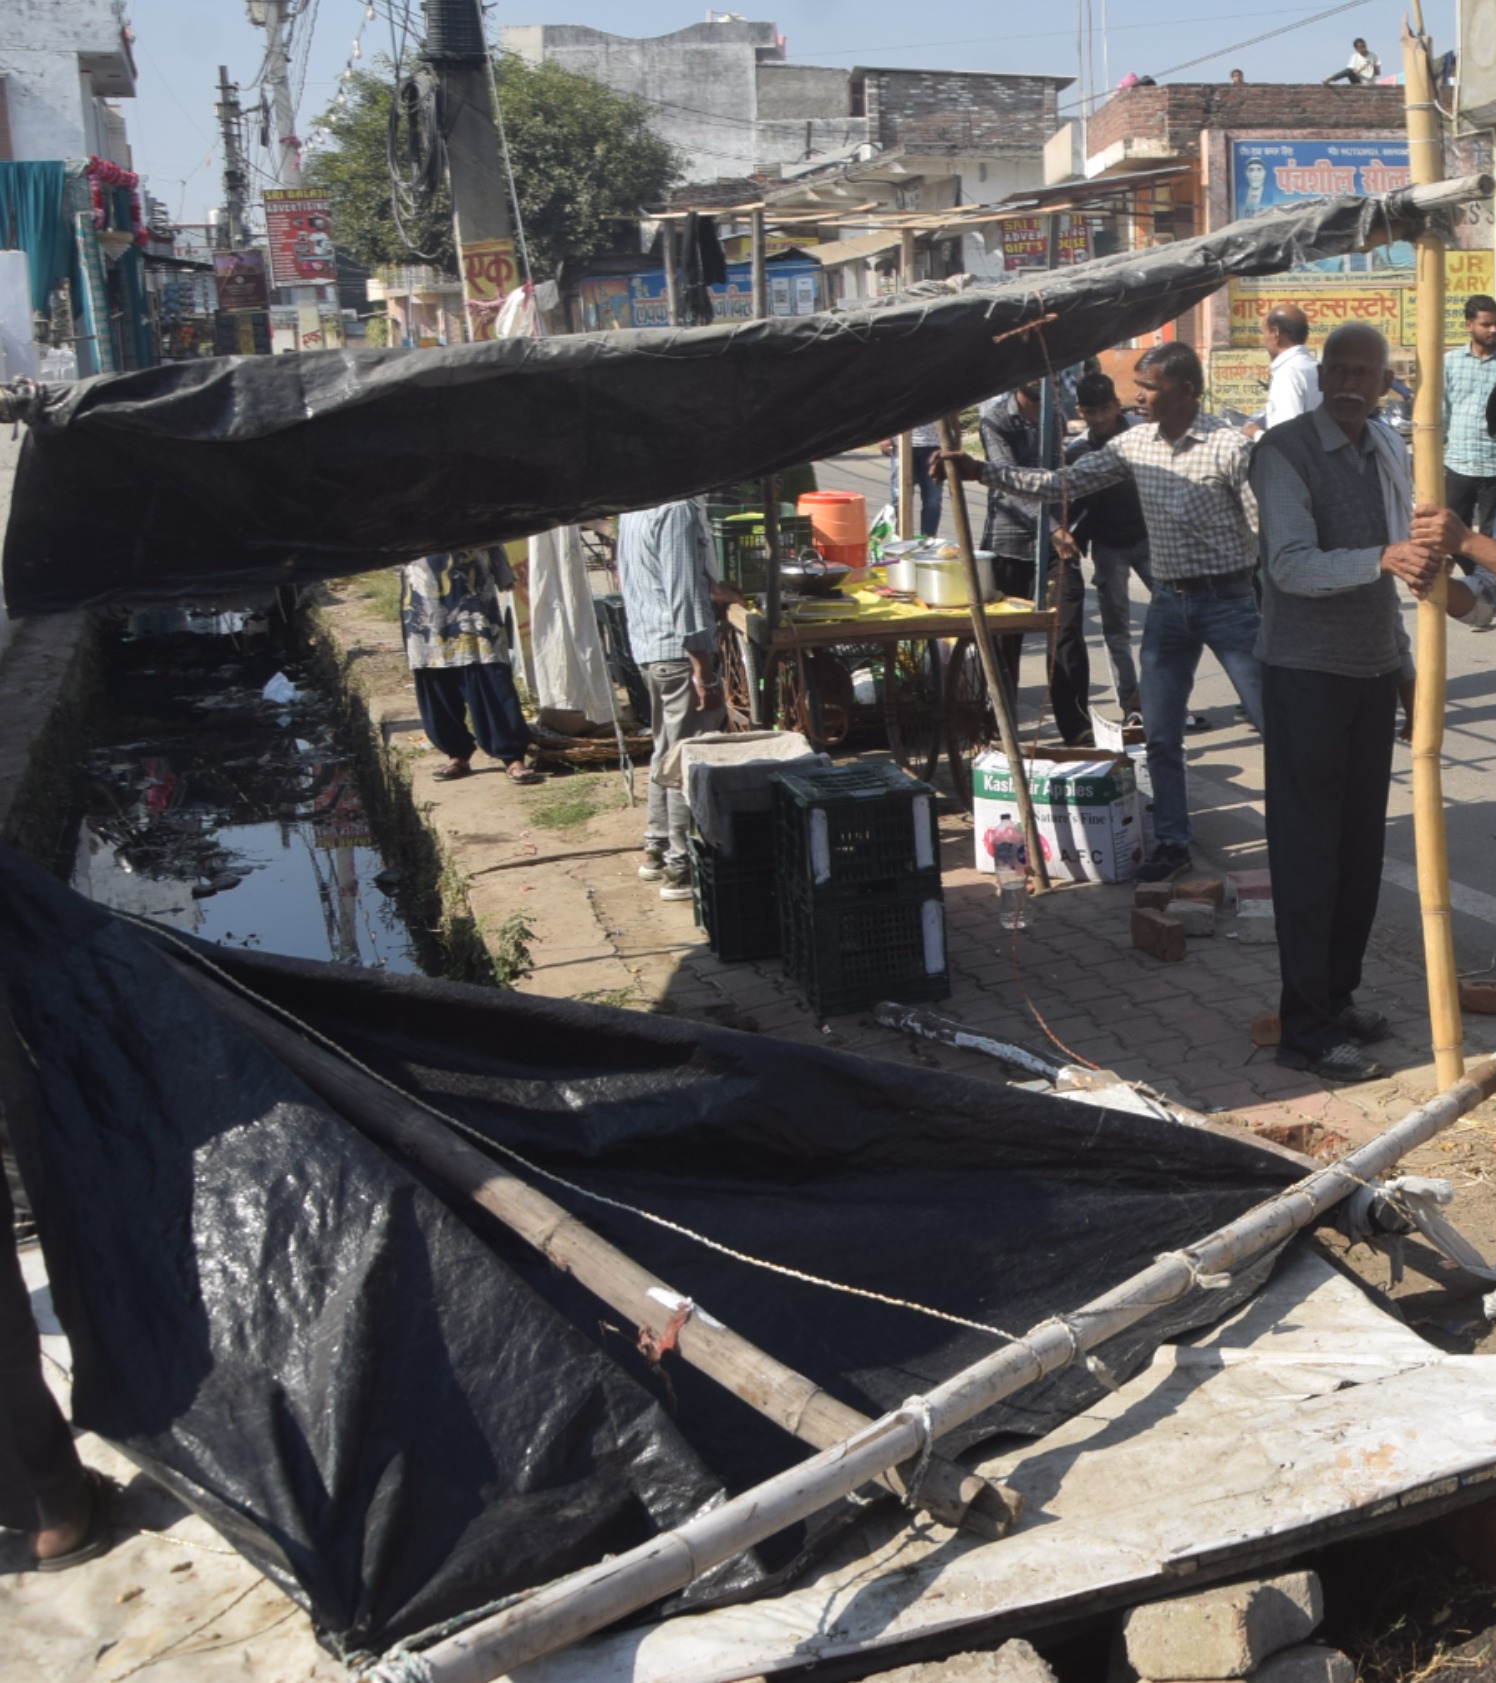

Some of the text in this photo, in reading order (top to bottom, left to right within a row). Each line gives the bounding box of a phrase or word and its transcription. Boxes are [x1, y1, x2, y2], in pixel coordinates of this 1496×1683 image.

[1273, 158, 1356, 194] पंचशील
[265, 188, 328, 201] SRI BALAJI
[266, 201, 329, 213] ADVERTISING
[1004, 219, 1028, 230] SRI
[1004, 237, 1087, 254] GIFT'S OUSE
[1448, 254, 1484, 274] JR
[463, 250, 514, 300] एक
[1444, 275, 1491, 293] RARY
[1278, 297, 1348, 324] इल्स
[1352, 292, 1399, 320] स्टोर
[983, 774, 1094, 799] Kashir Apples
[1060, 849, 1104, 864] A.F.C
